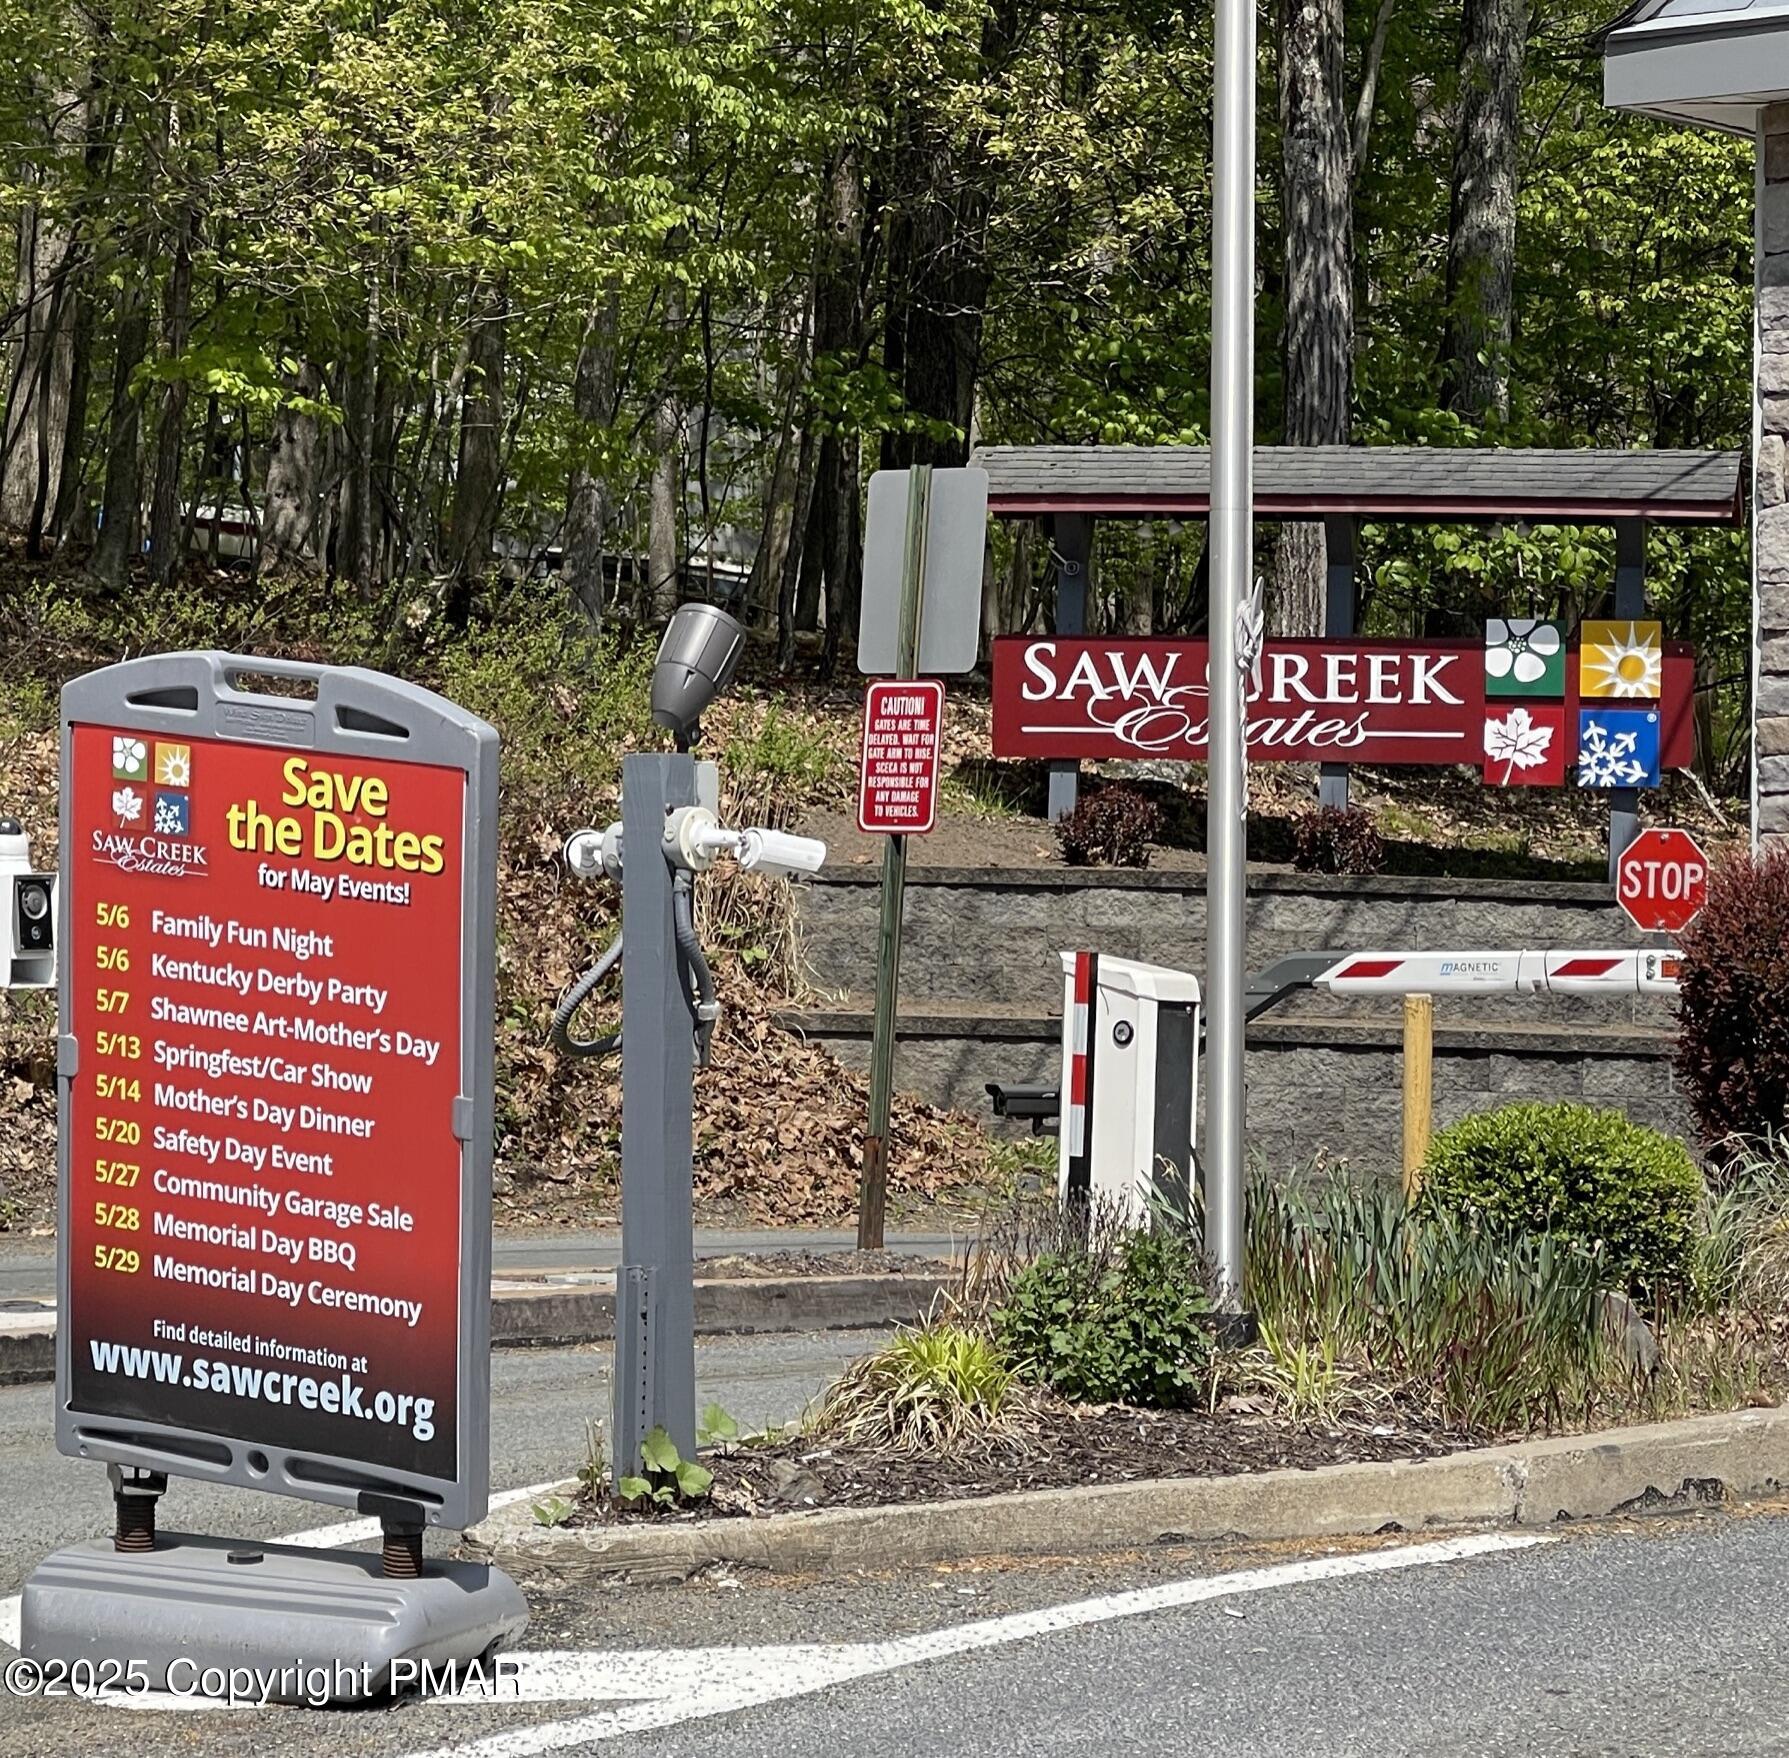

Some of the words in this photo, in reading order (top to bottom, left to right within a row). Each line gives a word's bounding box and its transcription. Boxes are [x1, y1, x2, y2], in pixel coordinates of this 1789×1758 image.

[1022, 642, 1183, 701] SAW
[1206, 653, 1465, 705] REEK
[874, 718, 896, 731] GATES
[897, 718, 912, 731] ARE
[913, 719, 931, 731] TIME
[880, 696, 925, 716] CAUTION!
[1087, 685, 1370, 752] Esates
[868, 733, 900, 746] DELAYED.
[902, 733, 919, 746] WAIT
[921, 733, 935, 746] FOR
[868, 747, 885, 759] GATE
[886, 747, 903, 759] ARM
[904, 747, 913, 759] TO
[914, 747, 933, 759] RISE.
[900, 762, 908, 774] IS
[909, 762, 923, 774] NOT
[282, 757, 388, 817] Save
[868, 776, 914, 788] RESPONSIBLE
[915, 776, 929, 789] FOR
[874, 805, 884, 817] TO
[885, 805, 919, 817] VEHICLES.
[875, 790, 890, 802] ANY
[891, 790, 919, 803] DAMAGE
[92, 829, 135, 855] SAW
[140, 836, 208, 865] CREEK
[110, 849, 185, 877] Estates
[226, 800, 303, 856] the
[313, 811, 444, 874] Dates
[257, 863, 288, 889] for
[291, 867, 334, 899] May
[338, 874, 410, 904] Events!
[1622, 861, 1704, 900] STOP
[96, 902, 130, 929] 5/6
[151, 910, 223, 948] Family
[227, 921, 267, 948] Fun
[272, 928, 333, 960] Night
[96, 946, 130, 972] 5/6
[151, 953, 253, 995] Kentucky
[258, 969, 323, 1005] Derby
[328, 981, 388, 1014] Party
[96, 989, 129, 1014] 5/7
[150, 996, 249, 1033] Shawnee
[253, 1012, 391, 1055] Art-Mother's
[396, 1032, 440, 1065] Day
[96, 1031, 141, 1060] 5/13
[153, 1039, 306, 1085] Springfest/Car
[311, 1063, 373, 1094] Show
[95, 1074, 141, 1103] 5/14
[154, 1082, 248, 1120] Mother's
[253, 1100, 295, 1133] Day
[299, 1109, 375, 1139] Dinner
[95, 1116, 141, 1146] 5/20
[153, 1125, 221, 1164] Safety
[225, 1137, 266, 1171] Day
[271, 1145, 333, 1176] Event
[95, 1159, 141, 1188] 5/27
[153, 1168, 281, 1216] Community
[284, 1189, 363, 1228] Garage
[367, 1202, 413, 1232] Sale
[94, 1202, 141, 1231] 5/28
[153, 1211, 257, 1251] Memorial
[261, 1229, 304, 1265] Day
[308, 1236, 357, 1271] BBQ
[94, 1245, 140, 1273] 5/29
[153, 1254, 257, 1294] Memorial
[261, 1271, 304, 1307] Day
[307, 1281, 422, 1326] Ceremony
[153, 1319, 186, 1343] Find
[189, 1324, 251, 1354] detailed
[255, 1335, 347, 1371] information
[351, 1353, 368, 1374] at
[90, 1338, 435, 1442] www.sawcreek.org
